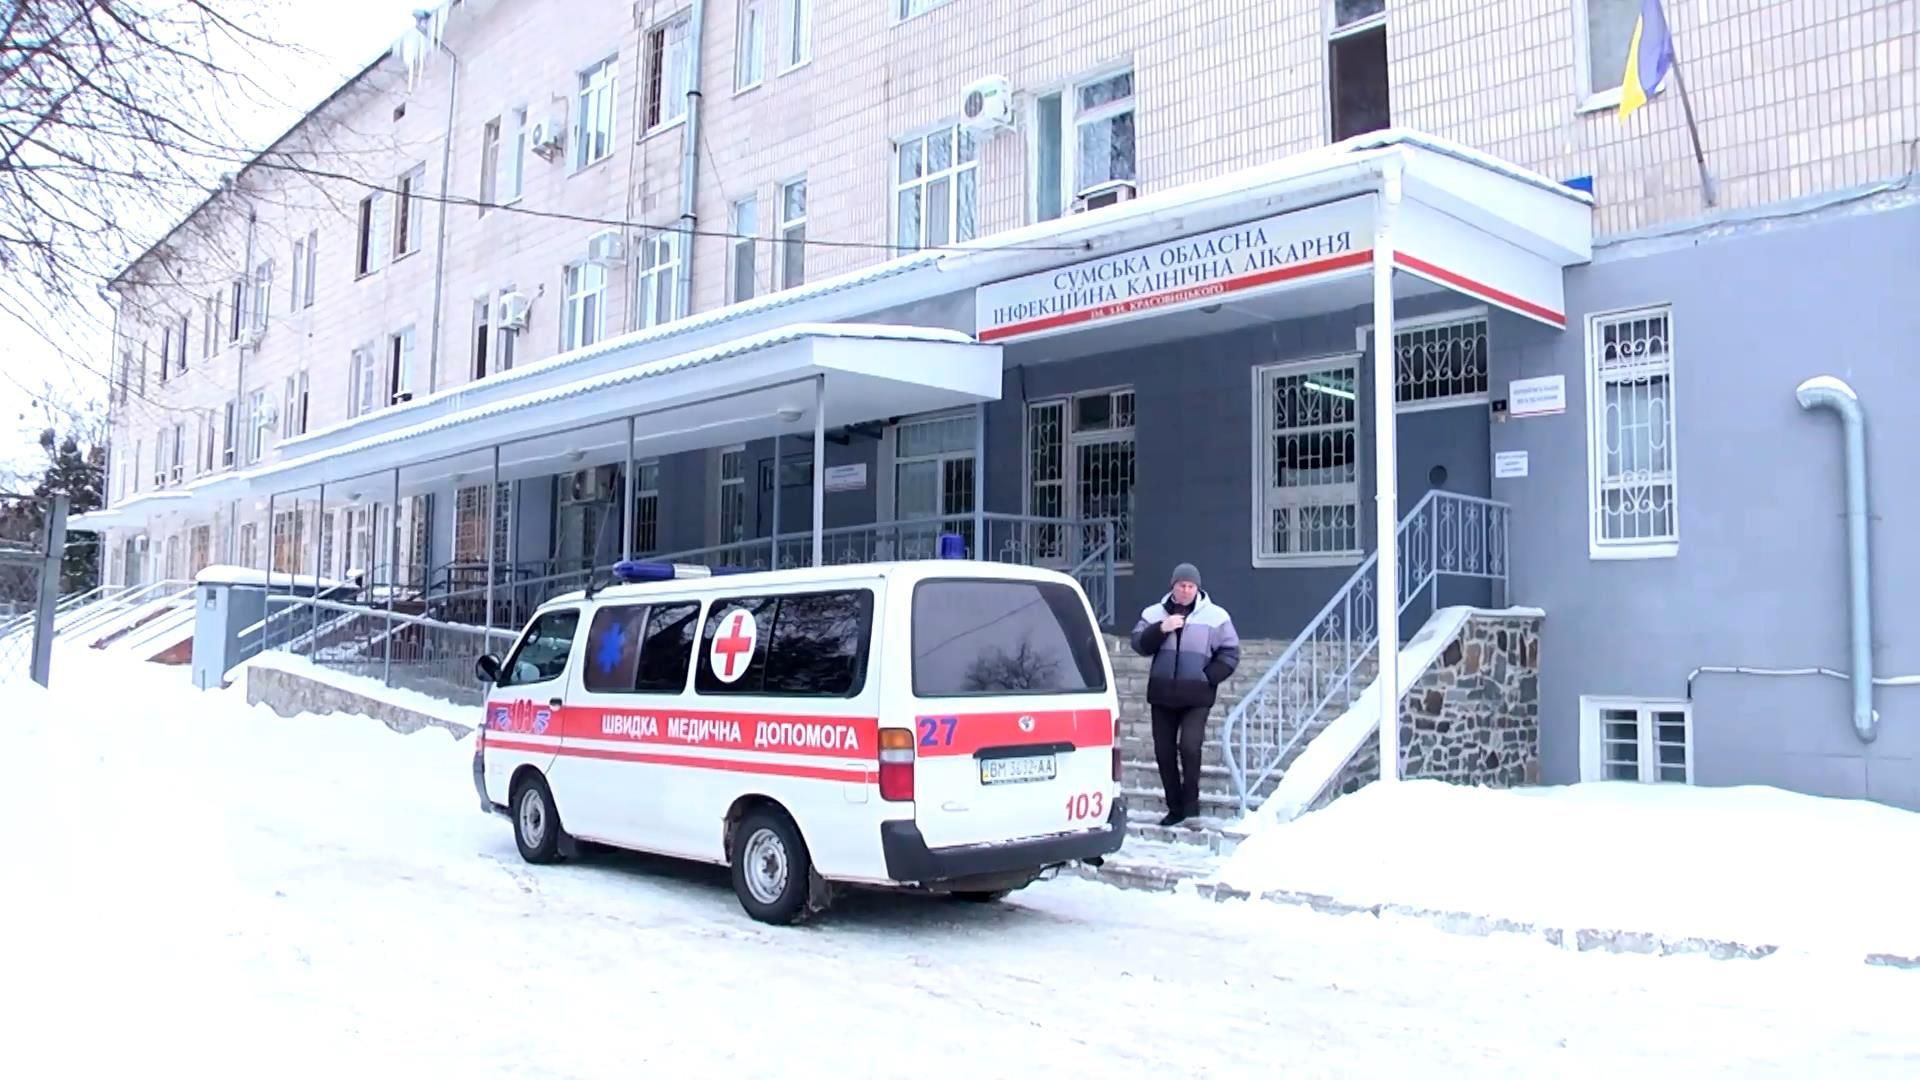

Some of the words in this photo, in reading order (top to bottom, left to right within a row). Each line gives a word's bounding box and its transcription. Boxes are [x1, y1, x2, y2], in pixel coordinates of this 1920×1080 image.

[1054, 255, 1151, 291] СУМСЬКА
[1160, 227, 1268, 267] ОБЛАСНА
[993, 286, 1117, 325] ІНФЕКЦІЙНА
[1127, 258, 1234, 297] КЛІНІЧНА
[1243, 231, 1352, 272] ЛІКАРНЯ
[601, 714, 658, 740] ШВИДКА
[668, 717, 742, 744] МЕДИЧНА
[754, 721, 860, 750] ДОПОМОГА
[919, 717, 958, 747] 27
[1066, 791, 1104, 821] 103
